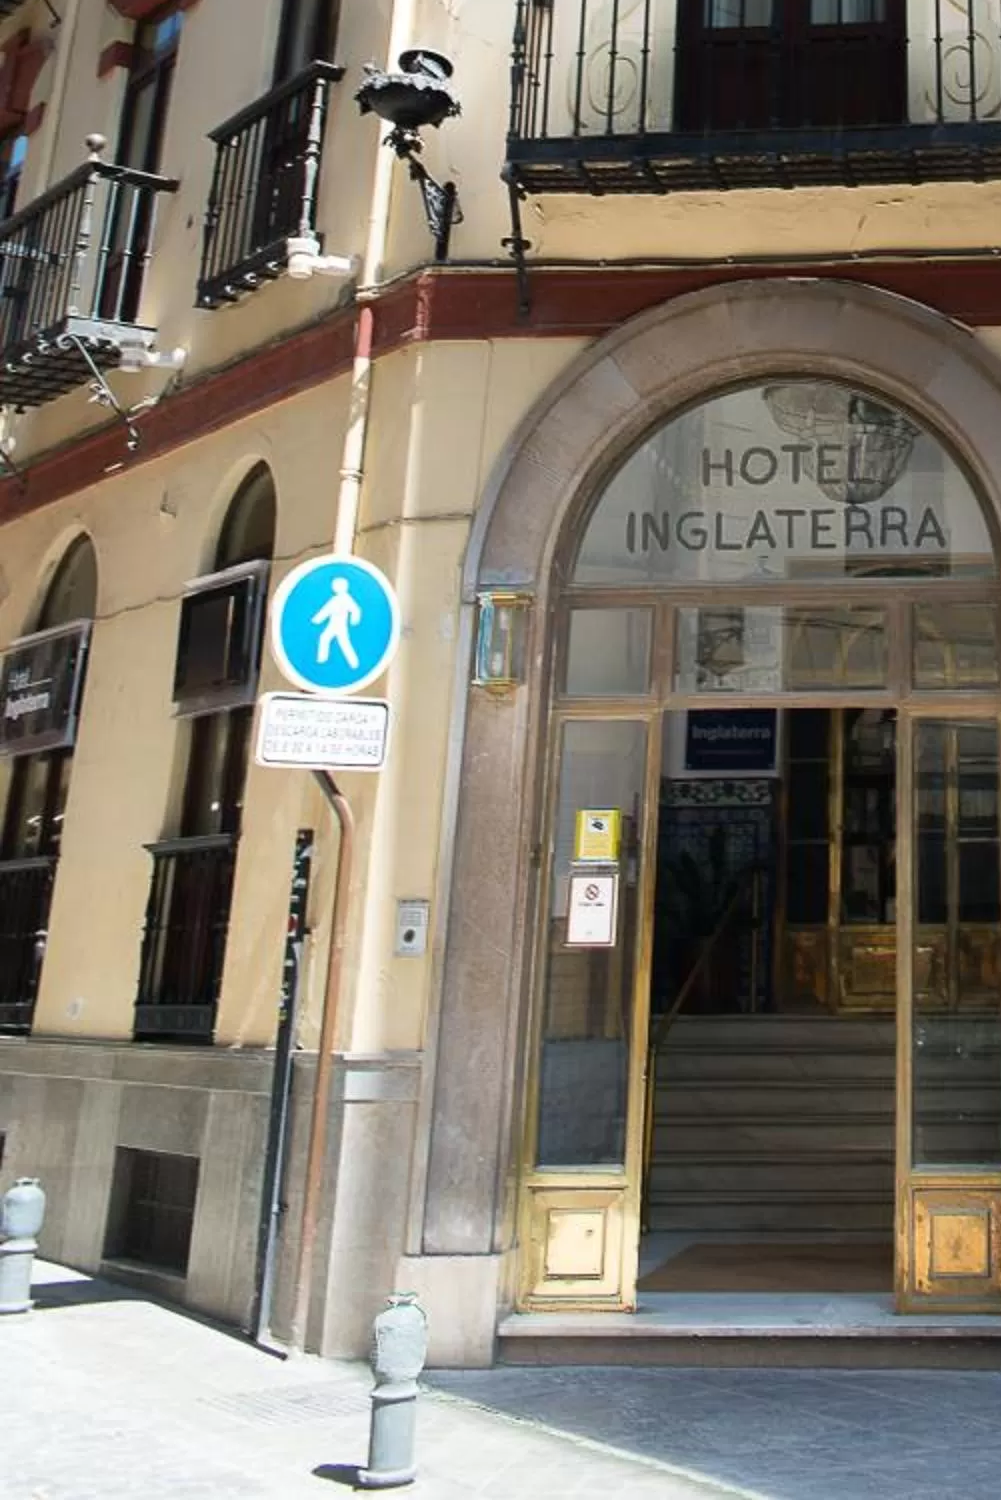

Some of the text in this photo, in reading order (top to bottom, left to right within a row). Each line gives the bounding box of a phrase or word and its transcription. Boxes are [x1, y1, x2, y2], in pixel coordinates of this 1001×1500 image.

[701, 443, 880, 487] HOTEL
[625, 505, 947, 553] INGLATERRA
[691, 723, 771, 742] Inglaterra
